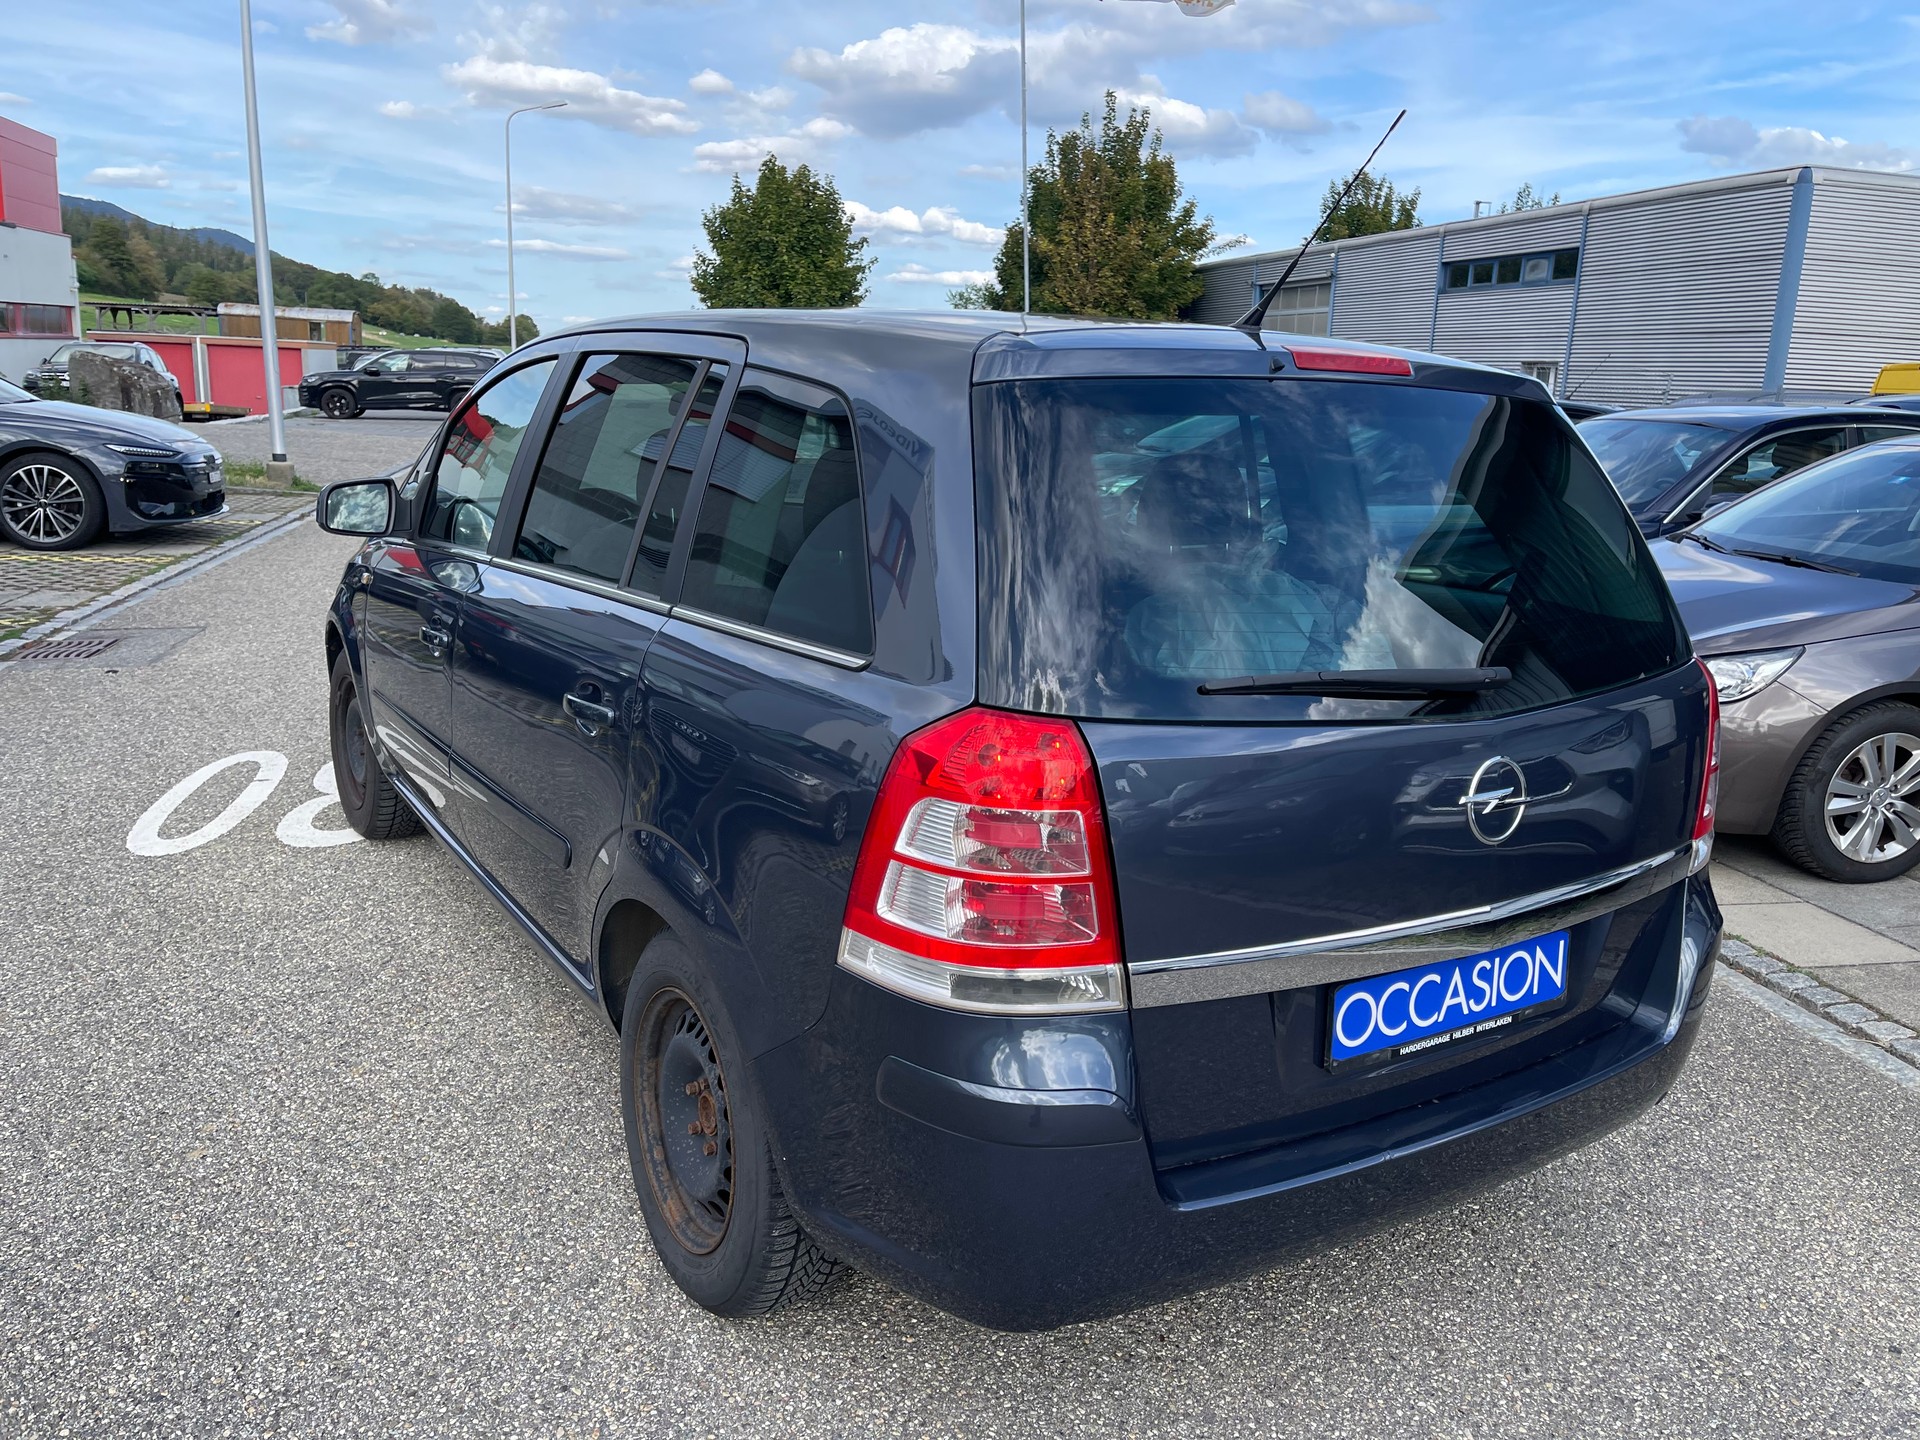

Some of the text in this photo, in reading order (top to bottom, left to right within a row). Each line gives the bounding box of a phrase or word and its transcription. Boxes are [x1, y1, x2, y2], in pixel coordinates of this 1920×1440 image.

[1336, 940, 1564, 1047] OCCASION
[1400, 1015, 1513, 1055] HARDERGARAGE HILBER INTERLAKEN
